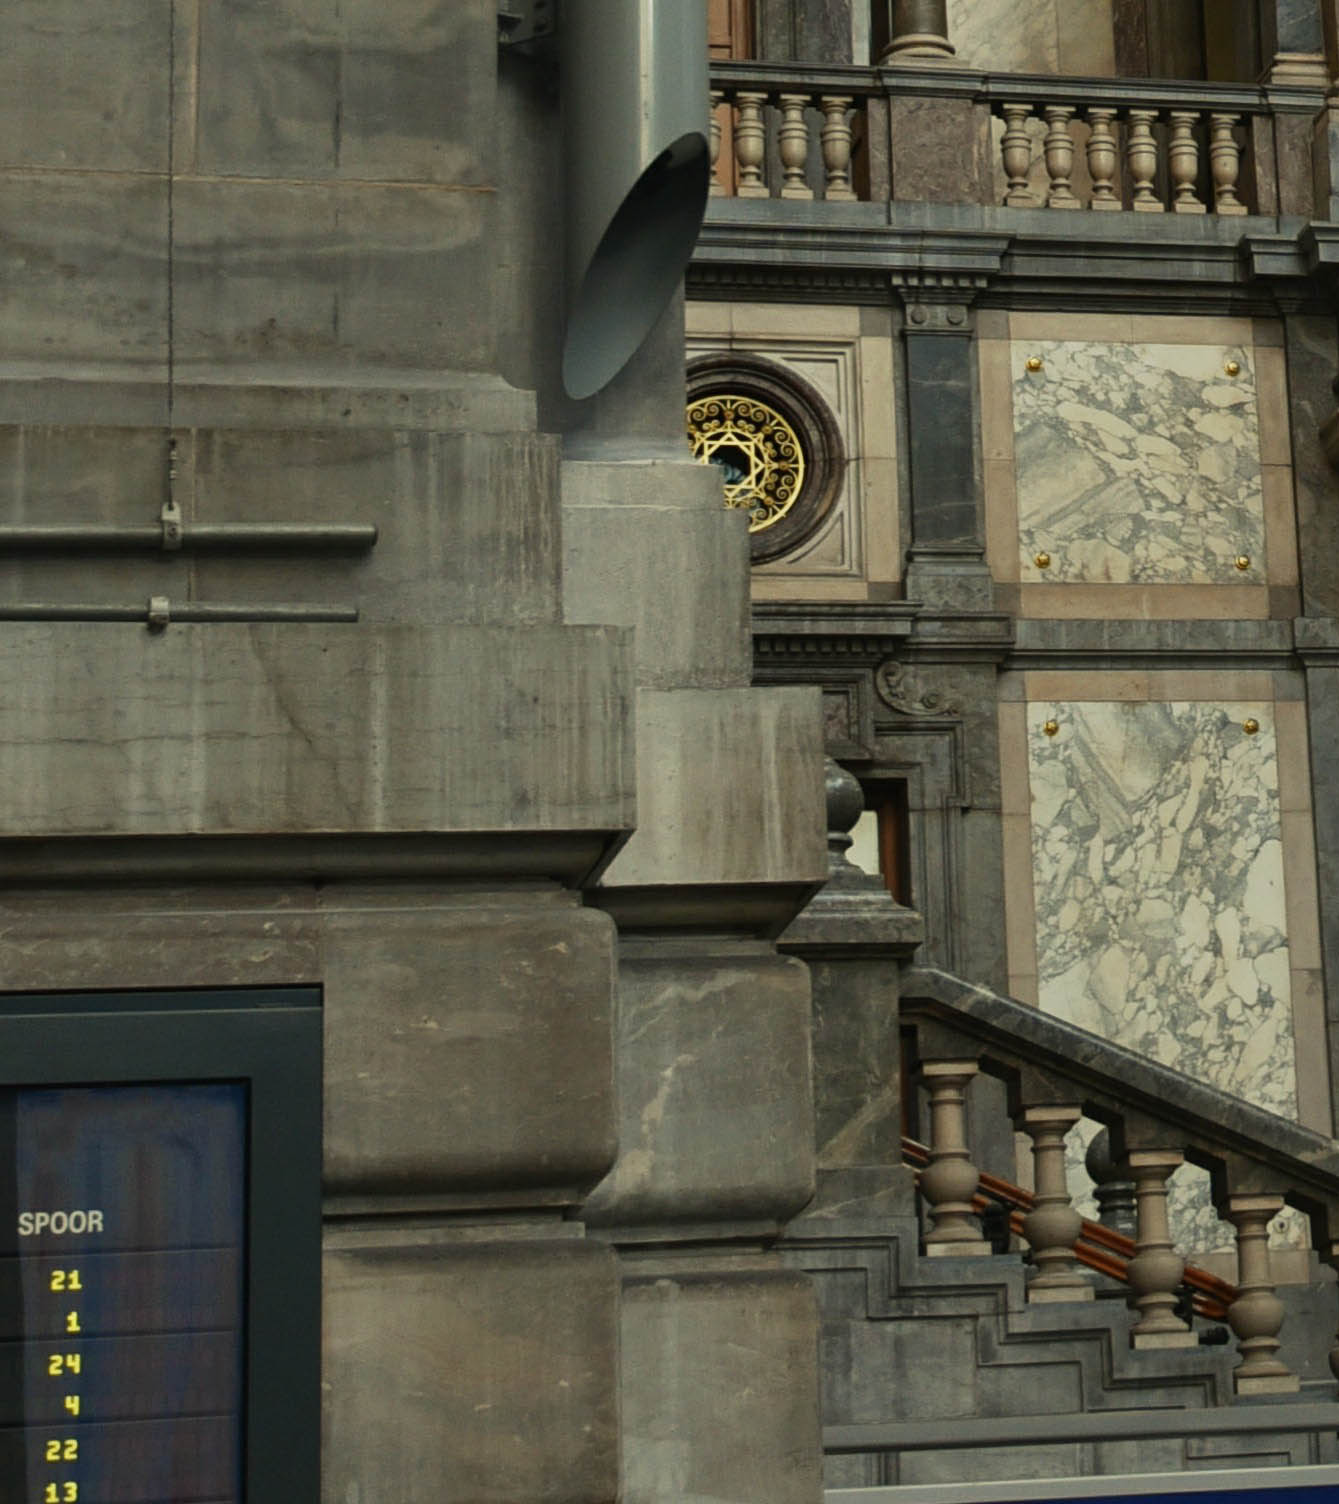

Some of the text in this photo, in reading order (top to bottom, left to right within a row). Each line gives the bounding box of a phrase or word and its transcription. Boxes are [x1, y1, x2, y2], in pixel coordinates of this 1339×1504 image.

[18, 1210, 104, 1236] SPOOR
[51, 1270, 82, 1291] 21
[66, 1311, 81, 1332] 1
[49, 1354, 81, 1375] 24
[64, 1396, 80, 1416] 4
[46, 1440, 79, 1461] 22
[46, 1483, 78, 1504] 13
